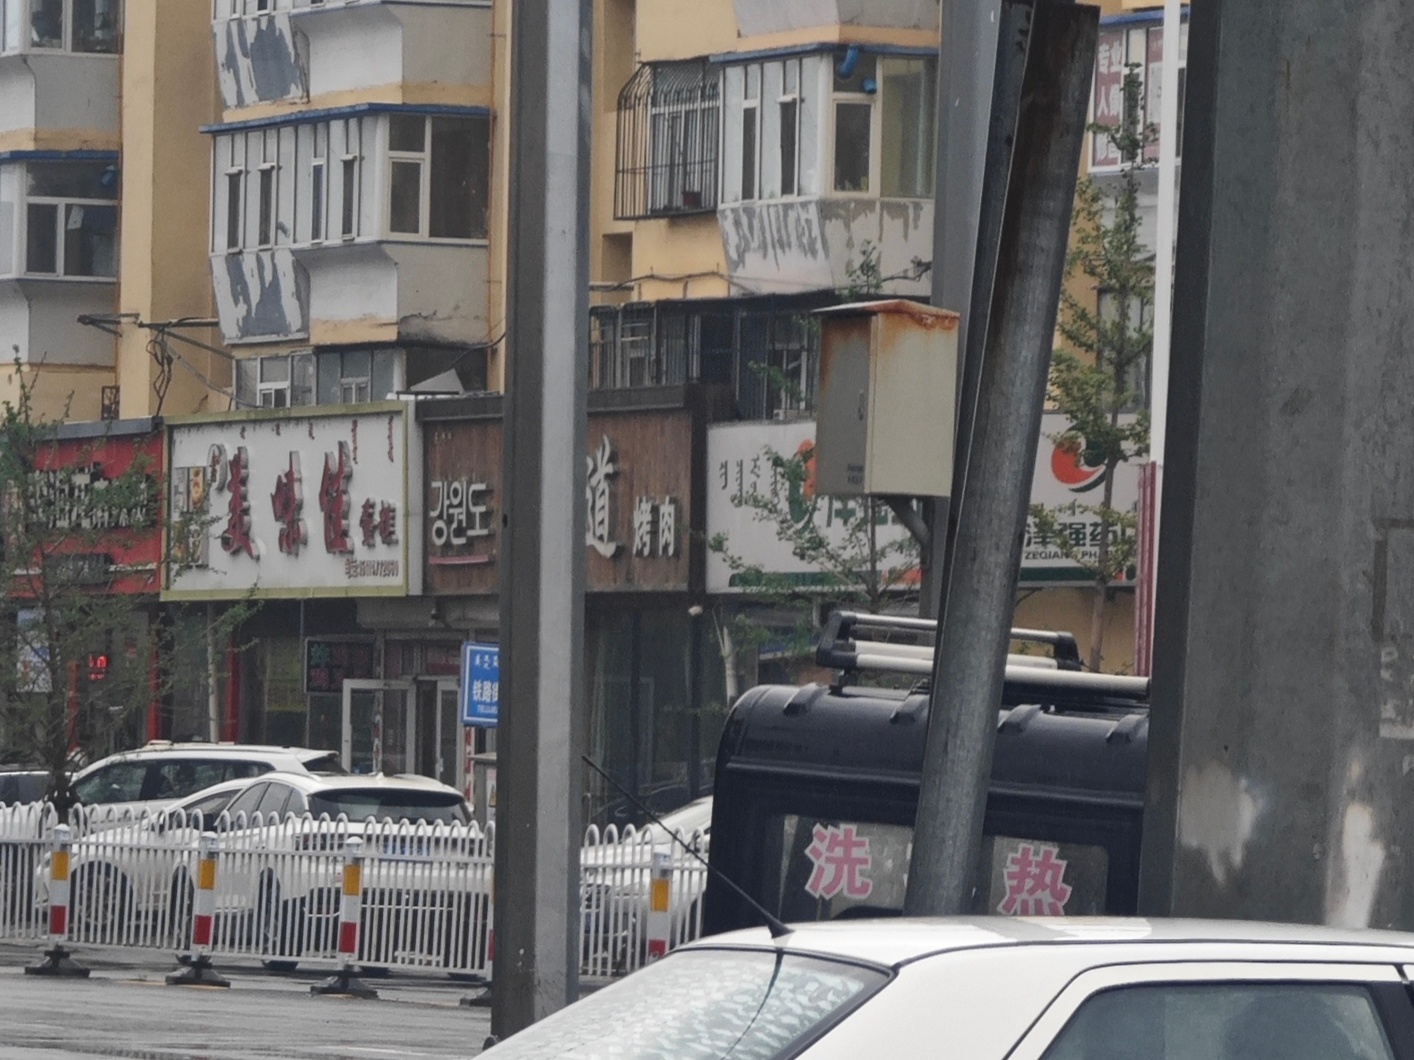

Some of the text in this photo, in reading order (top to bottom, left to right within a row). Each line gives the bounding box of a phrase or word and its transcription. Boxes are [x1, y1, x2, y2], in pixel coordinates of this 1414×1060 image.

[429, 478, 489, 546] 강원도
[633, 496, 674, 557] 烤肉
[805, 822, 873, 900] 洗
[1000, 842, 1073, 915] 热
